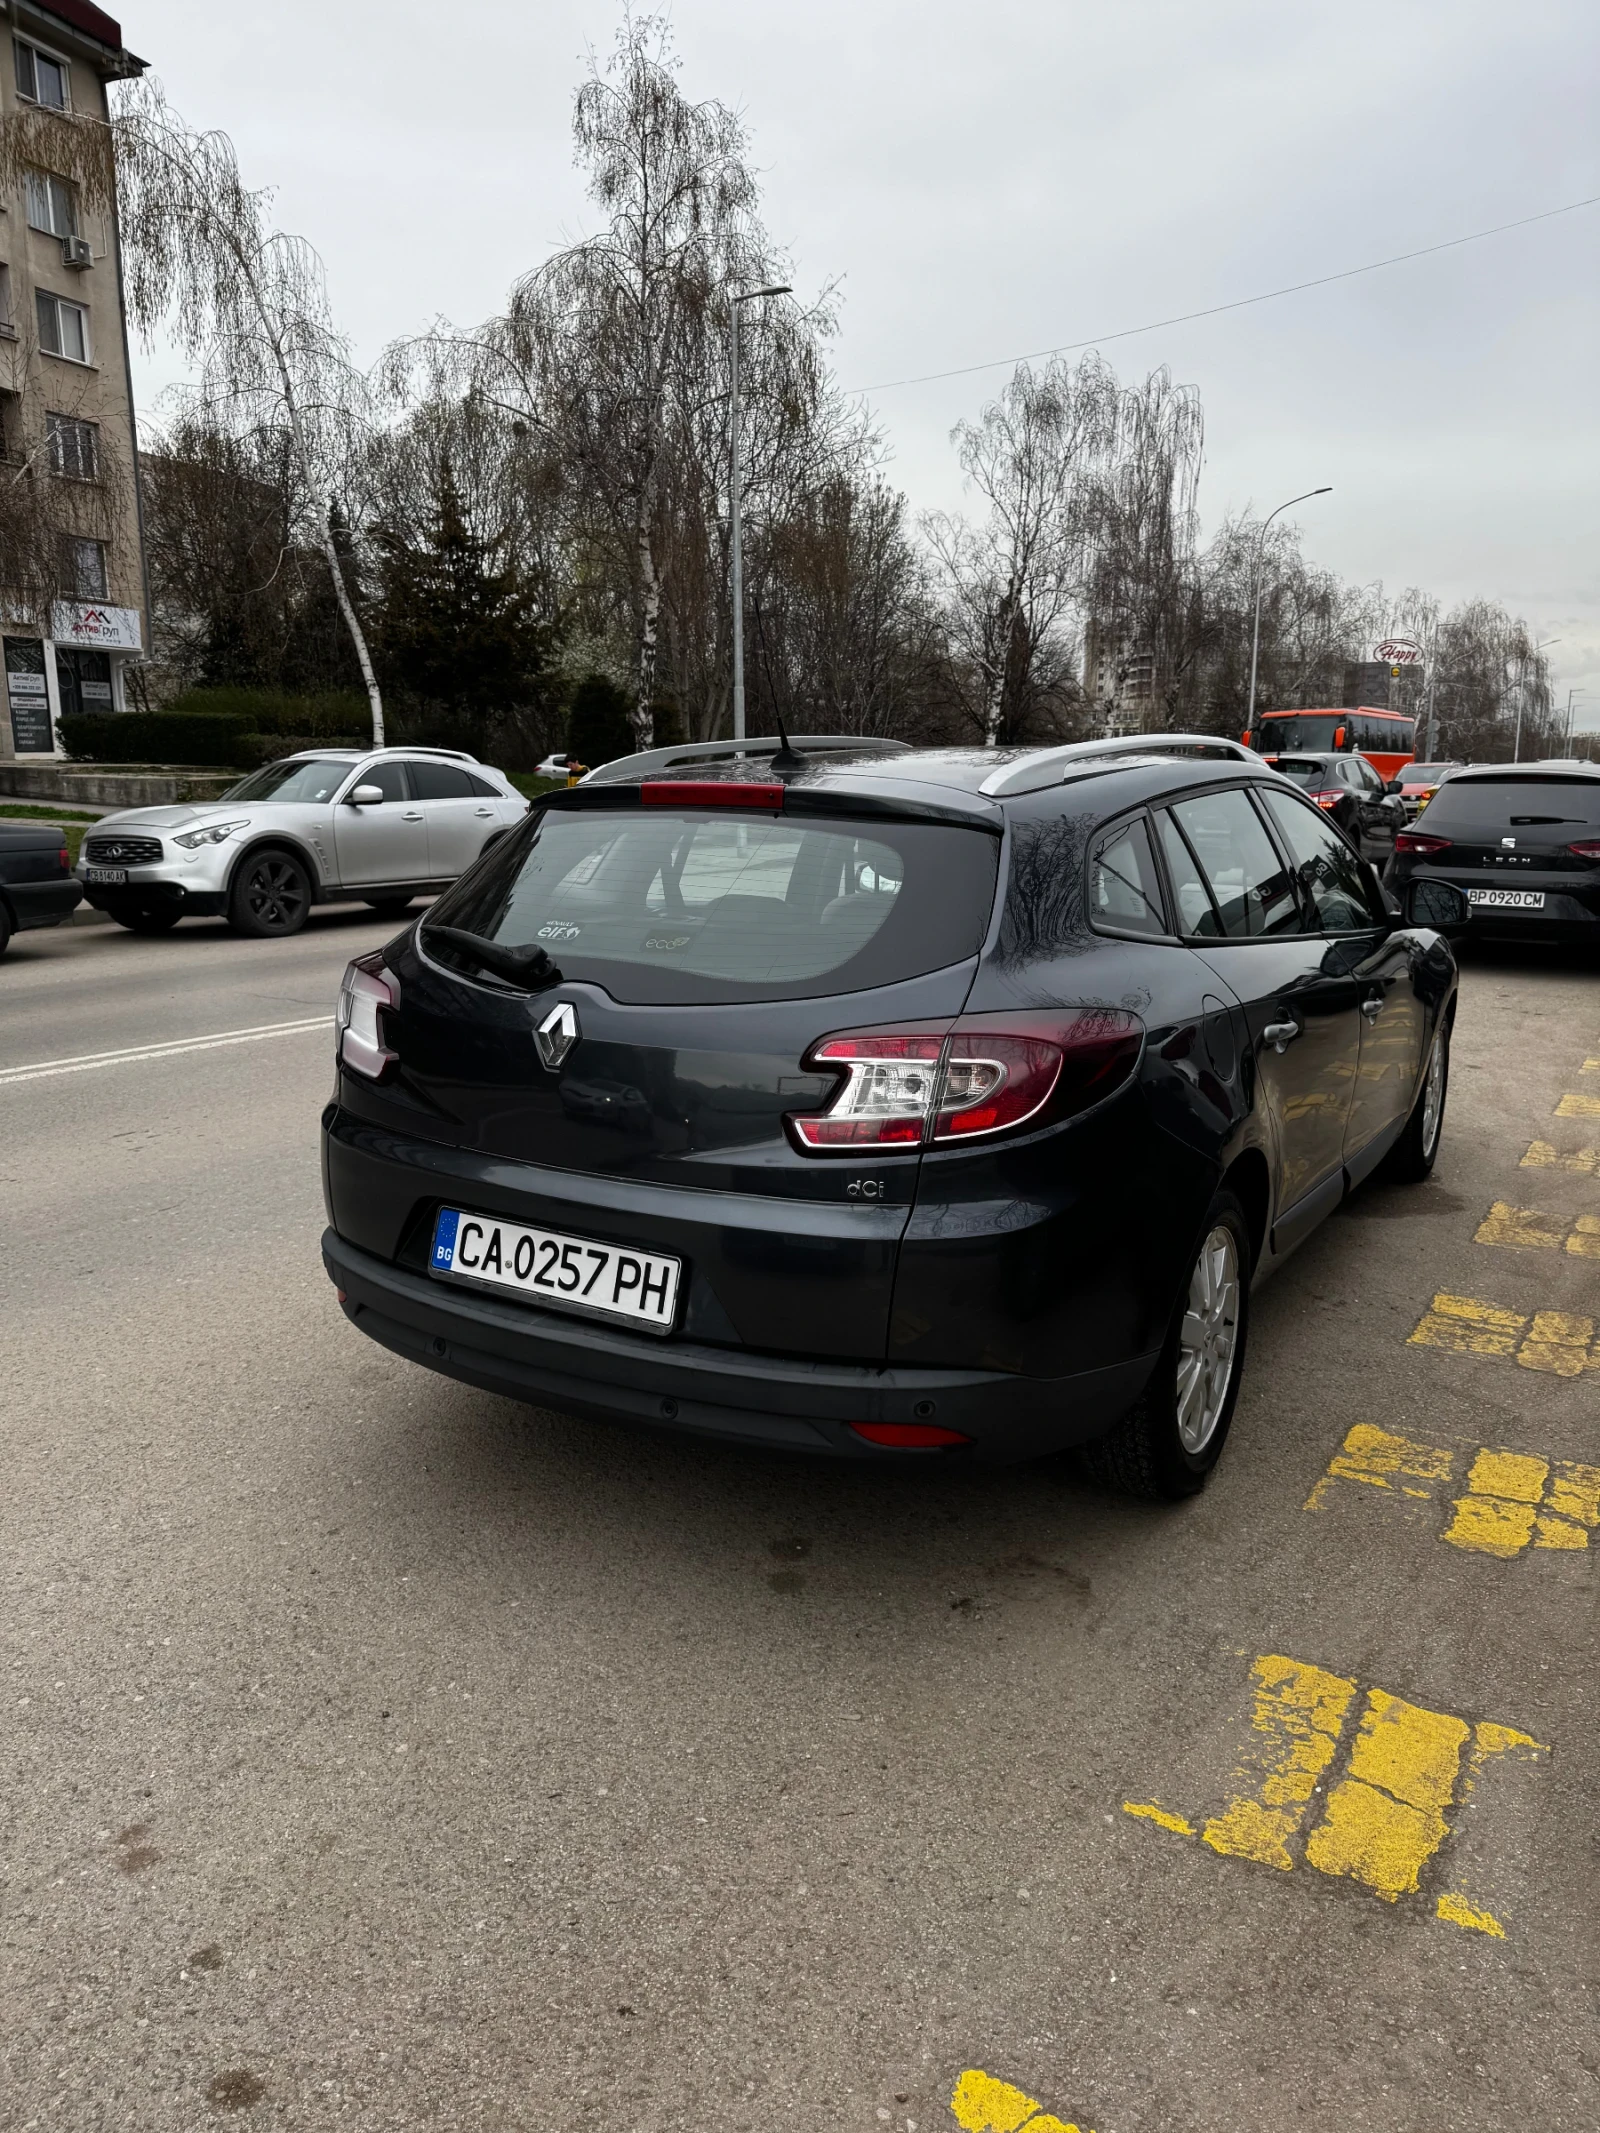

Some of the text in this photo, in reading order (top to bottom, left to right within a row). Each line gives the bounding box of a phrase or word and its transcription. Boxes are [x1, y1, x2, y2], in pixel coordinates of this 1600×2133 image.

[1379, 645, 1417, 662] Happy
[1469, 890, 1543, 906] BP 0920 CM
[537, 925, 567, 939] elf
[847, 1180, 884, 1197] dCi
[436, 1246, 452, 1261] BG
[458, 1222, 670, 1314] CA 0257 PH
